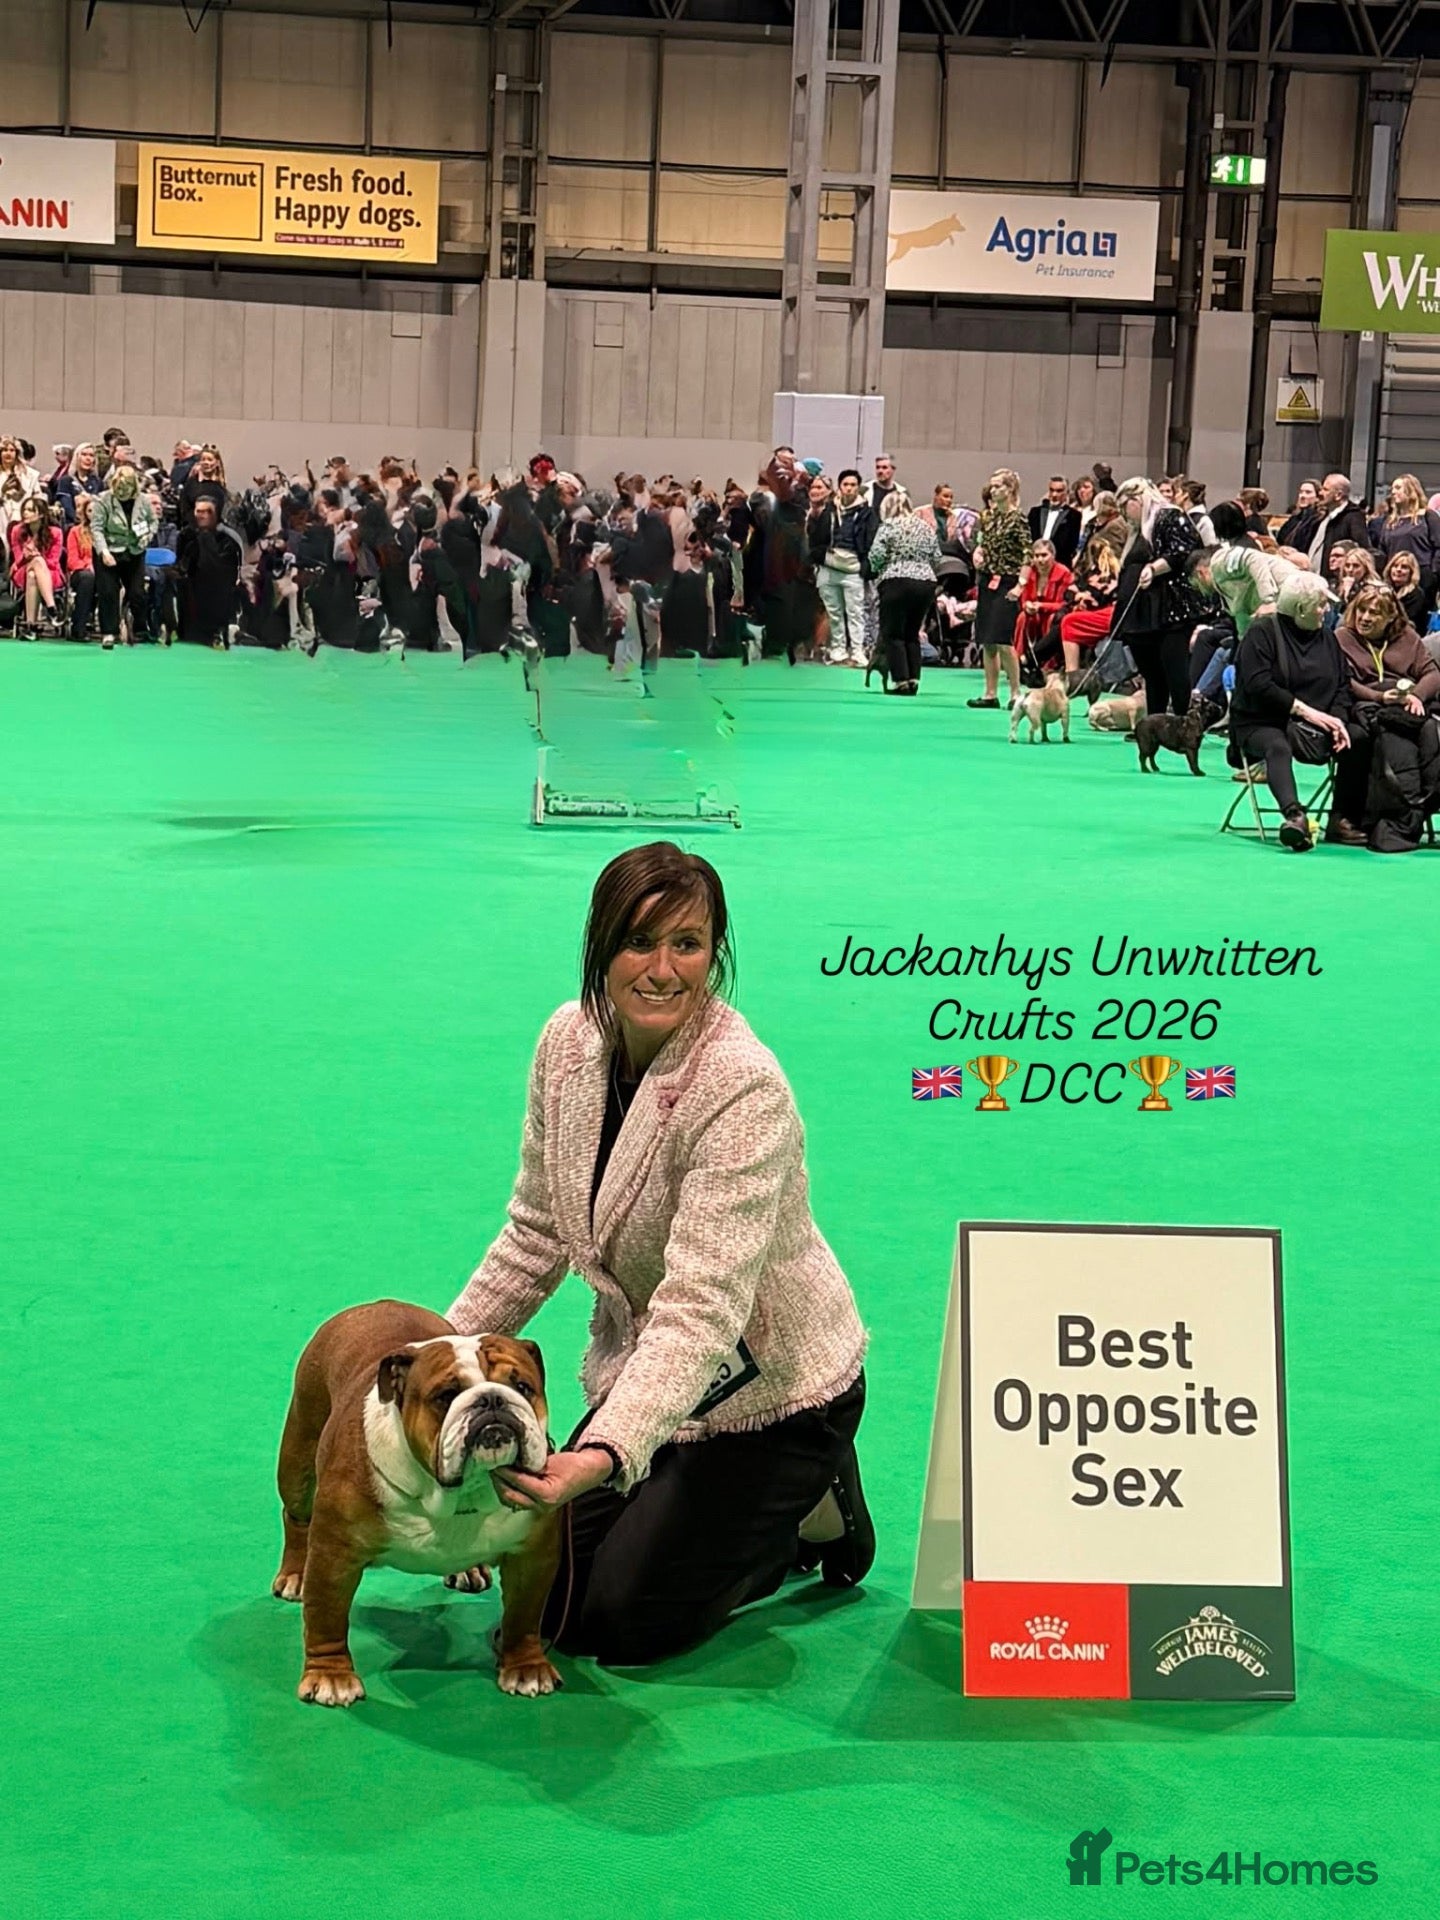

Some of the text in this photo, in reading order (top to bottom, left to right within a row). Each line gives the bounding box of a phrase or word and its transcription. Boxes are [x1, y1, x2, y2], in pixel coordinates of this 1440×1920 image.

[160, 164, 257, 187] Butternut
[160, 182, 203, 202] Box.
[275, 165, 413, 196] Fresh food.
[274, 196, 422, 232] Happy dogs.
[985, 216, 1088, 262] Agria
[1035, 263, 1116, 279] Pet Insurance
[1058, 1314, 1193, 1370] Best
[993, 1378, 1258, 1446] Opposite
[1071, 1452, 1184, 1508] Sex
[990, 1642, 1105, 1661] ROYAL CANIN
[1185, 1626, 1239, 1645] JAMES
[1155, 1641, 1265, 1678] WELLBELOVED
